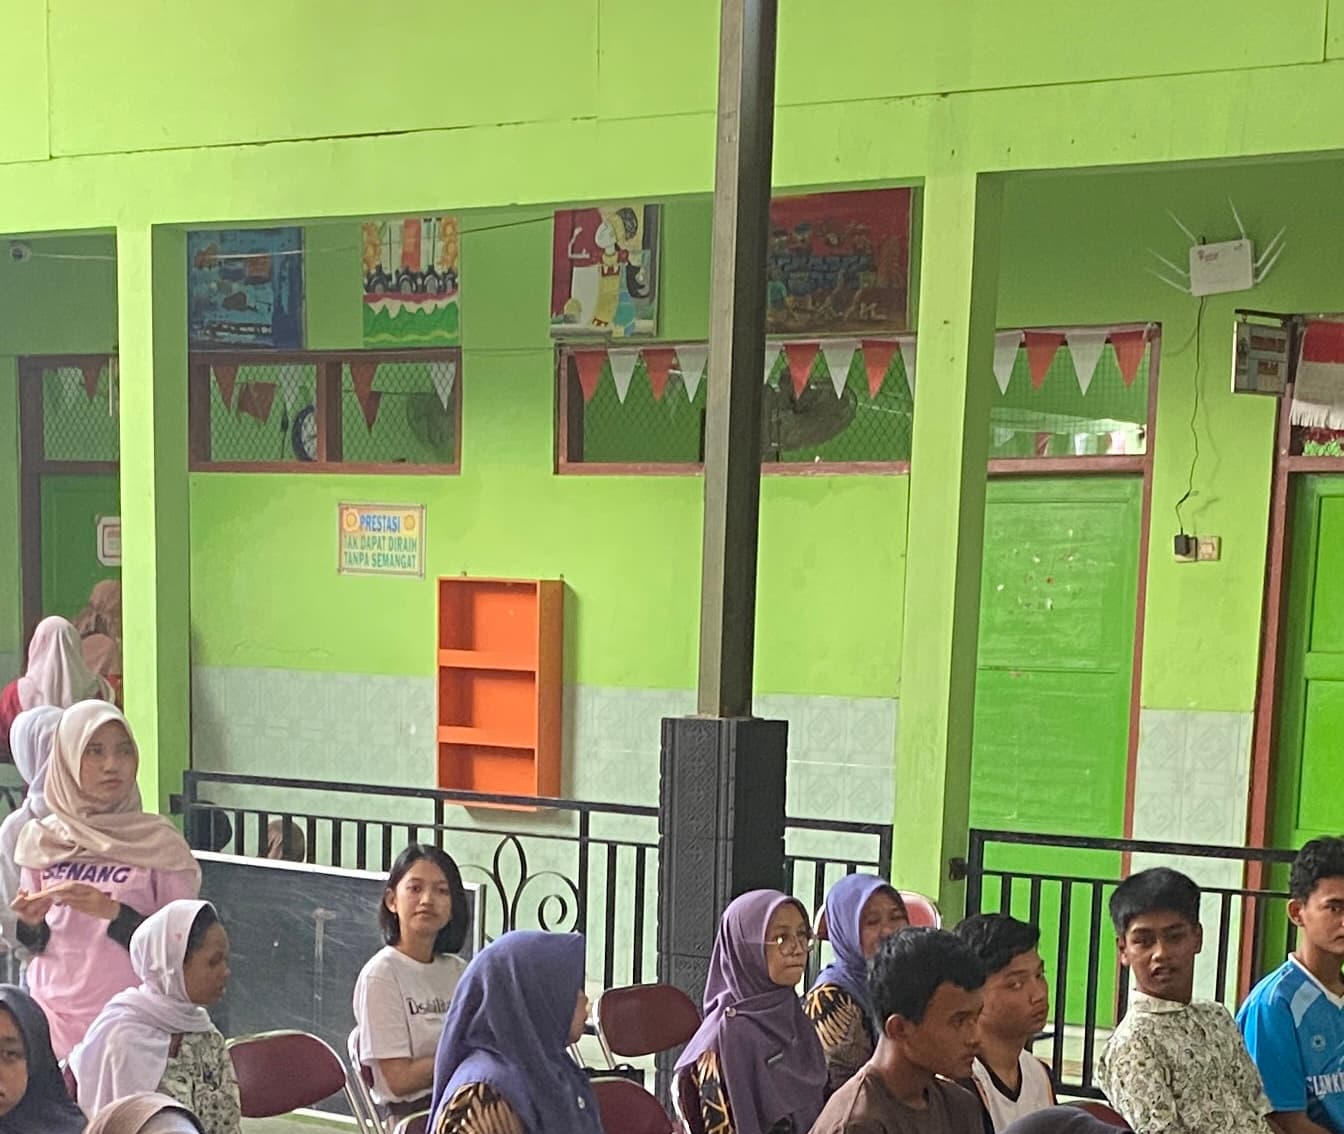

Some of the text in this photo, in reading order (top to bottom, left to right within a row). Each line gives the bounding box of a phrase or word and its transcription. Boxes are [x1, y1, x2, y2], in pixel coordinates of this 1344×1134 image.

[360, 514, 400, 532] PRESTASI
[361, 535, 386, 550] DAPAT
[344, 551, 416, 568] TANPA SEMANGAT
[43, 862, 131, 883] SENANG
